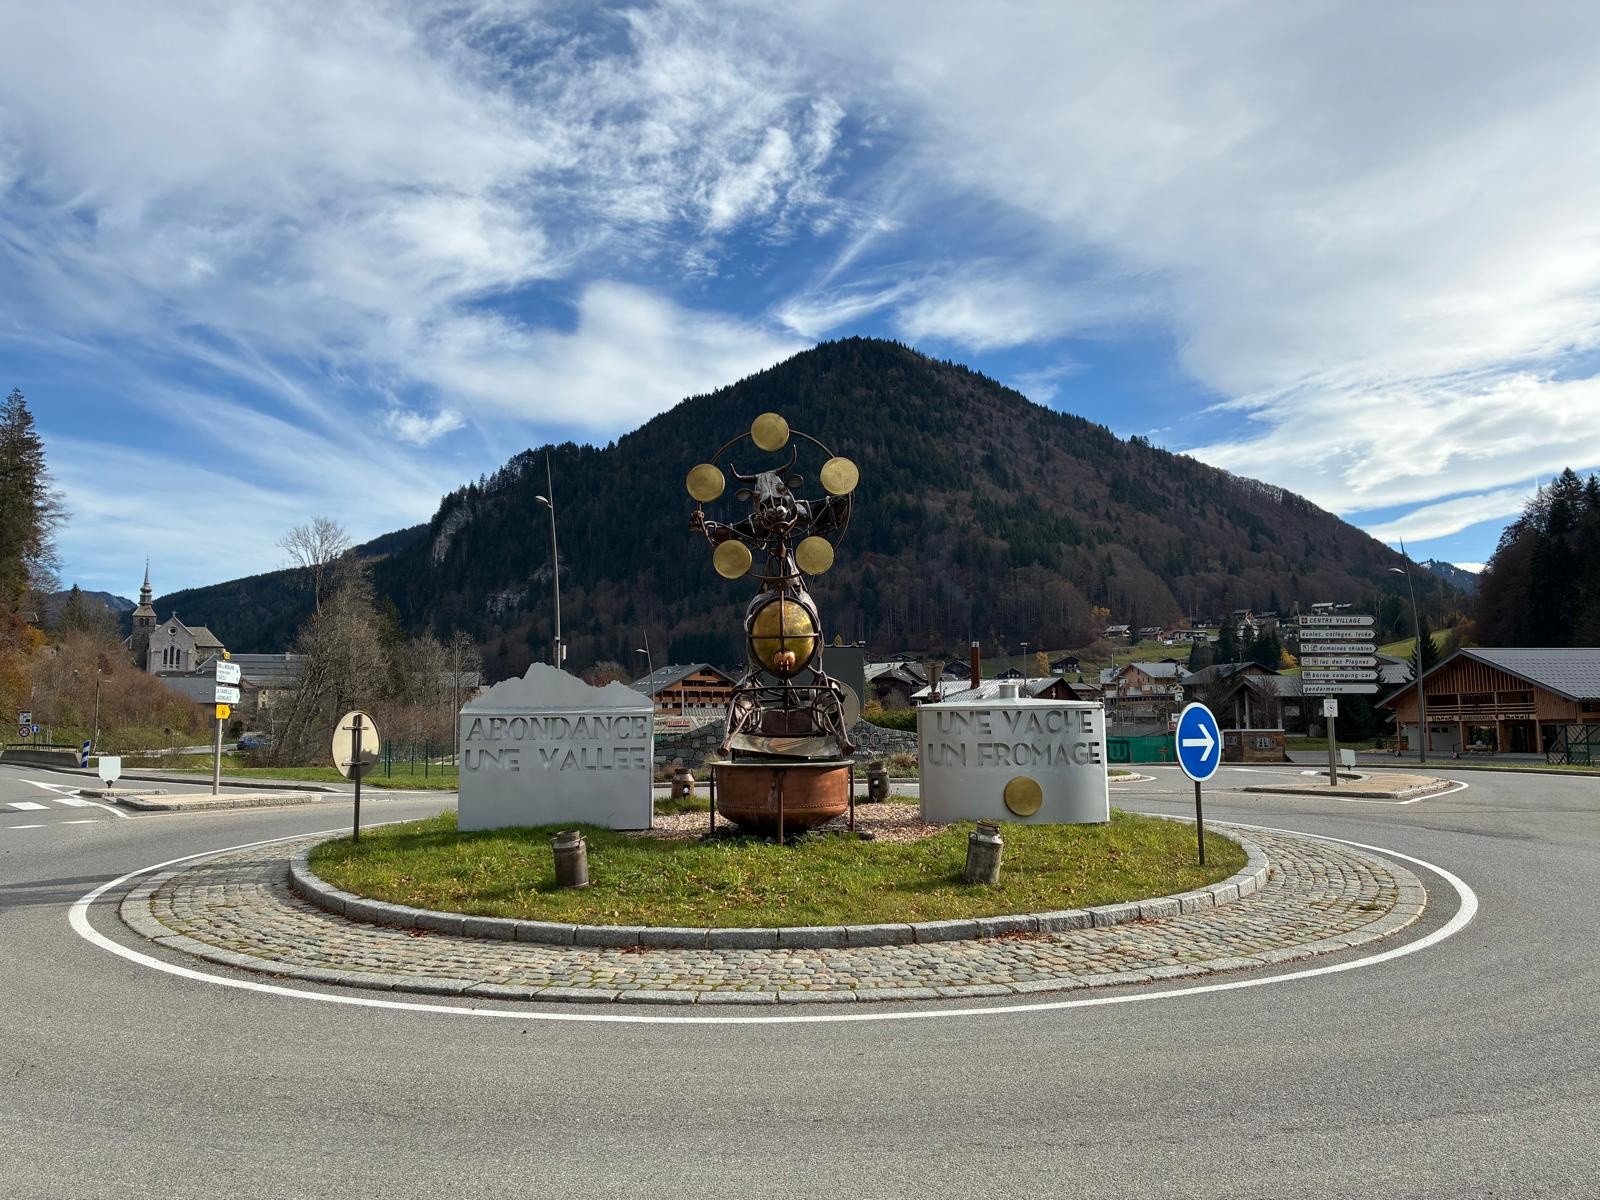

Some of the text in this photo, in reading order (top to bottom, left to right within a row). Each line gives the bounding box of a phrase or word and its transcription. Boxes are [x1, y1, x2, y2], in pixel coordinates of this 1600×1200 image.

[465, 715, 647, 741] ABONDANCE
[936, 710, 1094, 735] UNE VACHE
[465, 747, 646, 772] UNE VALLEE
[928, 741, 1101, 767] UN FROMAGE
